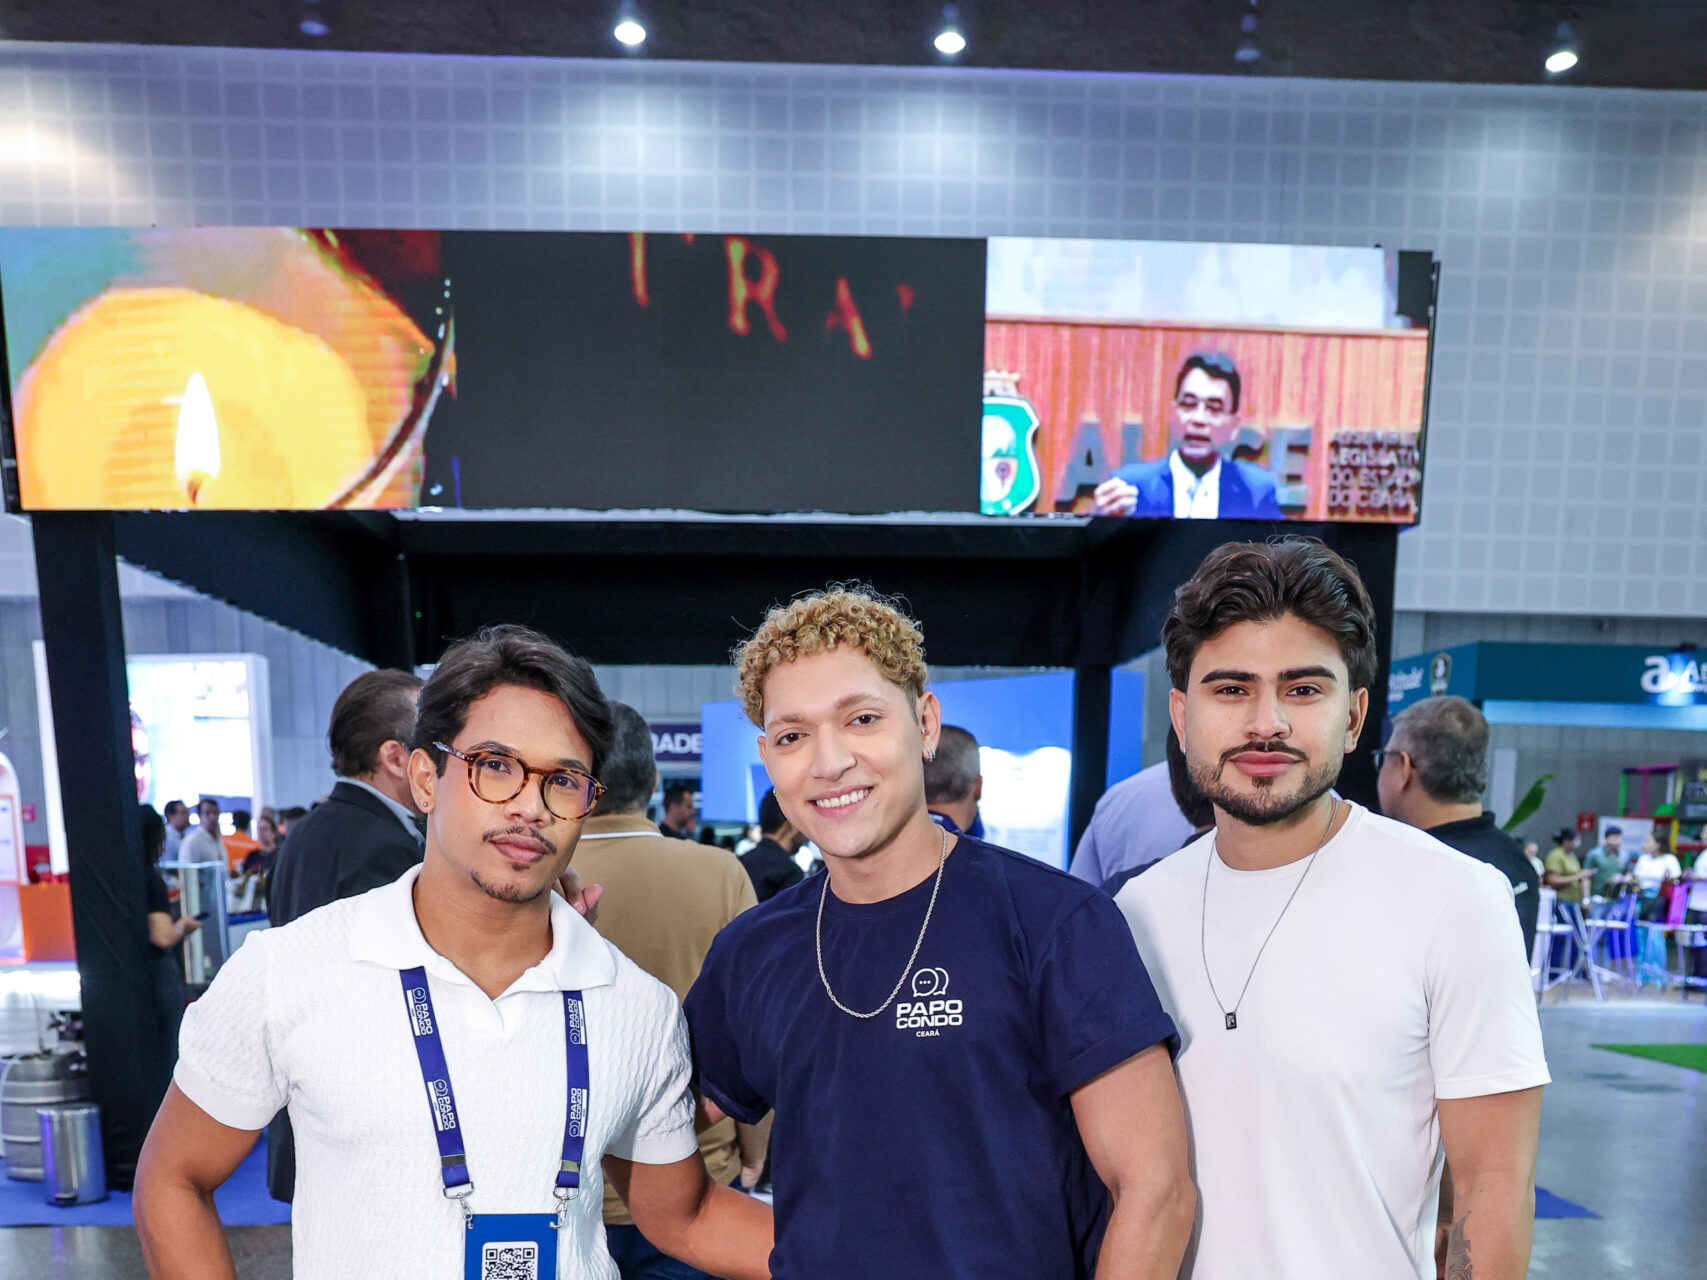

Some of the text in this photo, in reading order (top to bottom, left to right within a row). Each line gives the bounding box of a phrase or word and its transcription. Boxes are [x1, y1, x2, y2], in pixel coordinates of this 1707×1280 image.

[896, 1000, 963, 1018] PAPO
[421, 1003, 433, 1034] PAPO
[896, 1014, 963, 1029] CONDO
[916, 1029, 940, 1037] CEARÁ
[443, 1096, 456, 1129] PAPO
